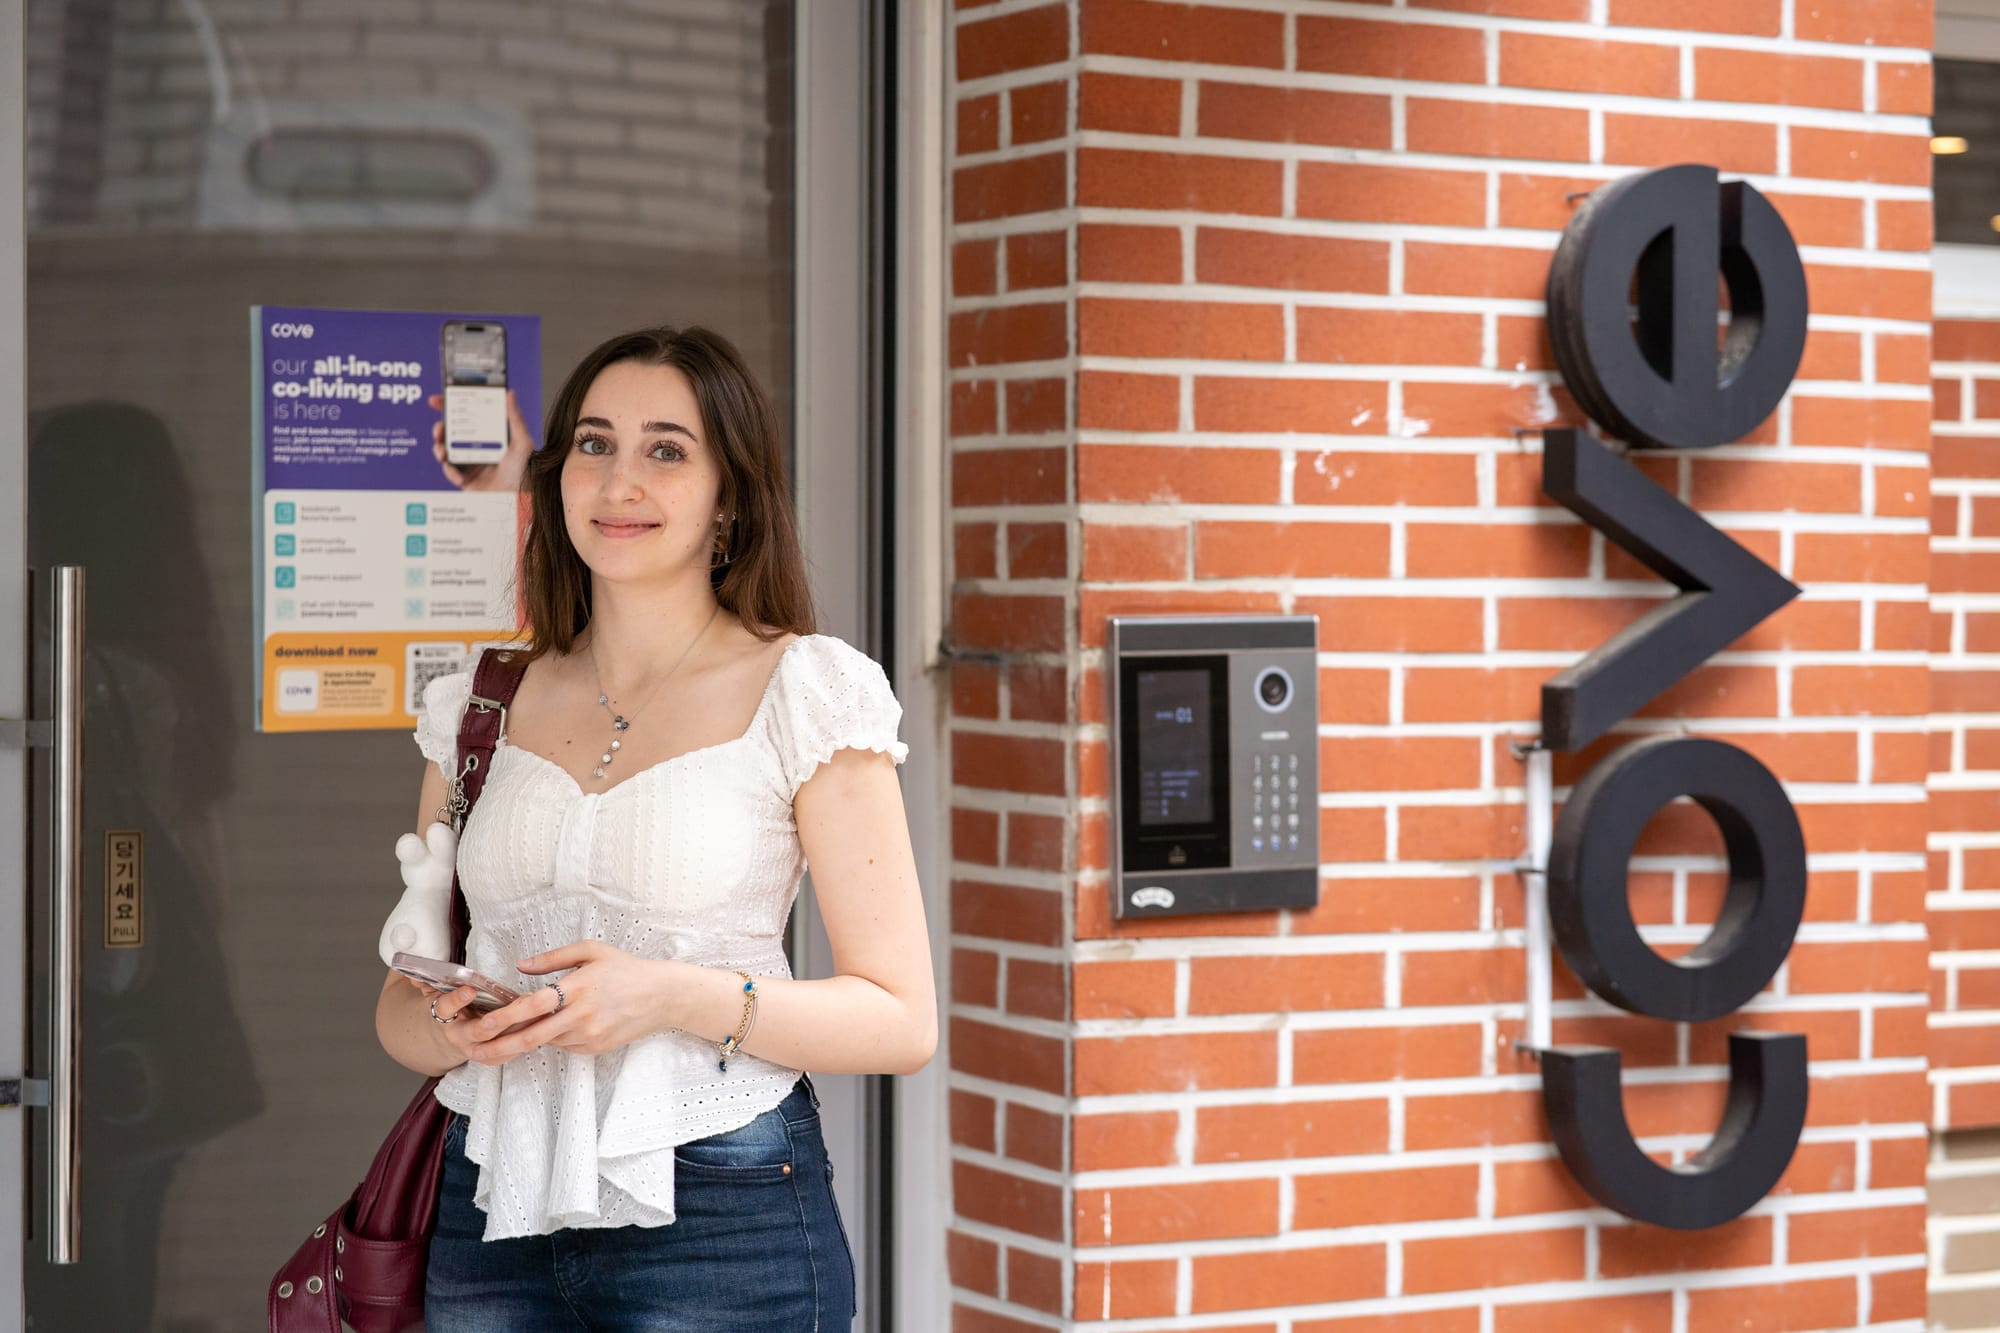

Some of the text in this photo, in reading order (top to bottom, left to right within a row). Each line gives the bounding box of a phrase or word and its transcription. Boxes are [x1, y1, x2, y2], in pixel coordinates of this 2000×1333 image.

[271, 323, 314, 339] cove
[272, 355, 422, 378] our all-in-one
[272, 377, 422, 405] co-living app
[273, 400, 341, 420] is here
[291, 426, 307, 435] and
[308, 427, 329, 436] book
[331, 427, 358, 436] rooms
[311, 437, 358, 446] community
[275, 645, 378, 657] download now
[1542, 163, 1808, 1230] cove
[115, 841, 135, 920] 당기세요
[113, 927, 136, 937] PULL
